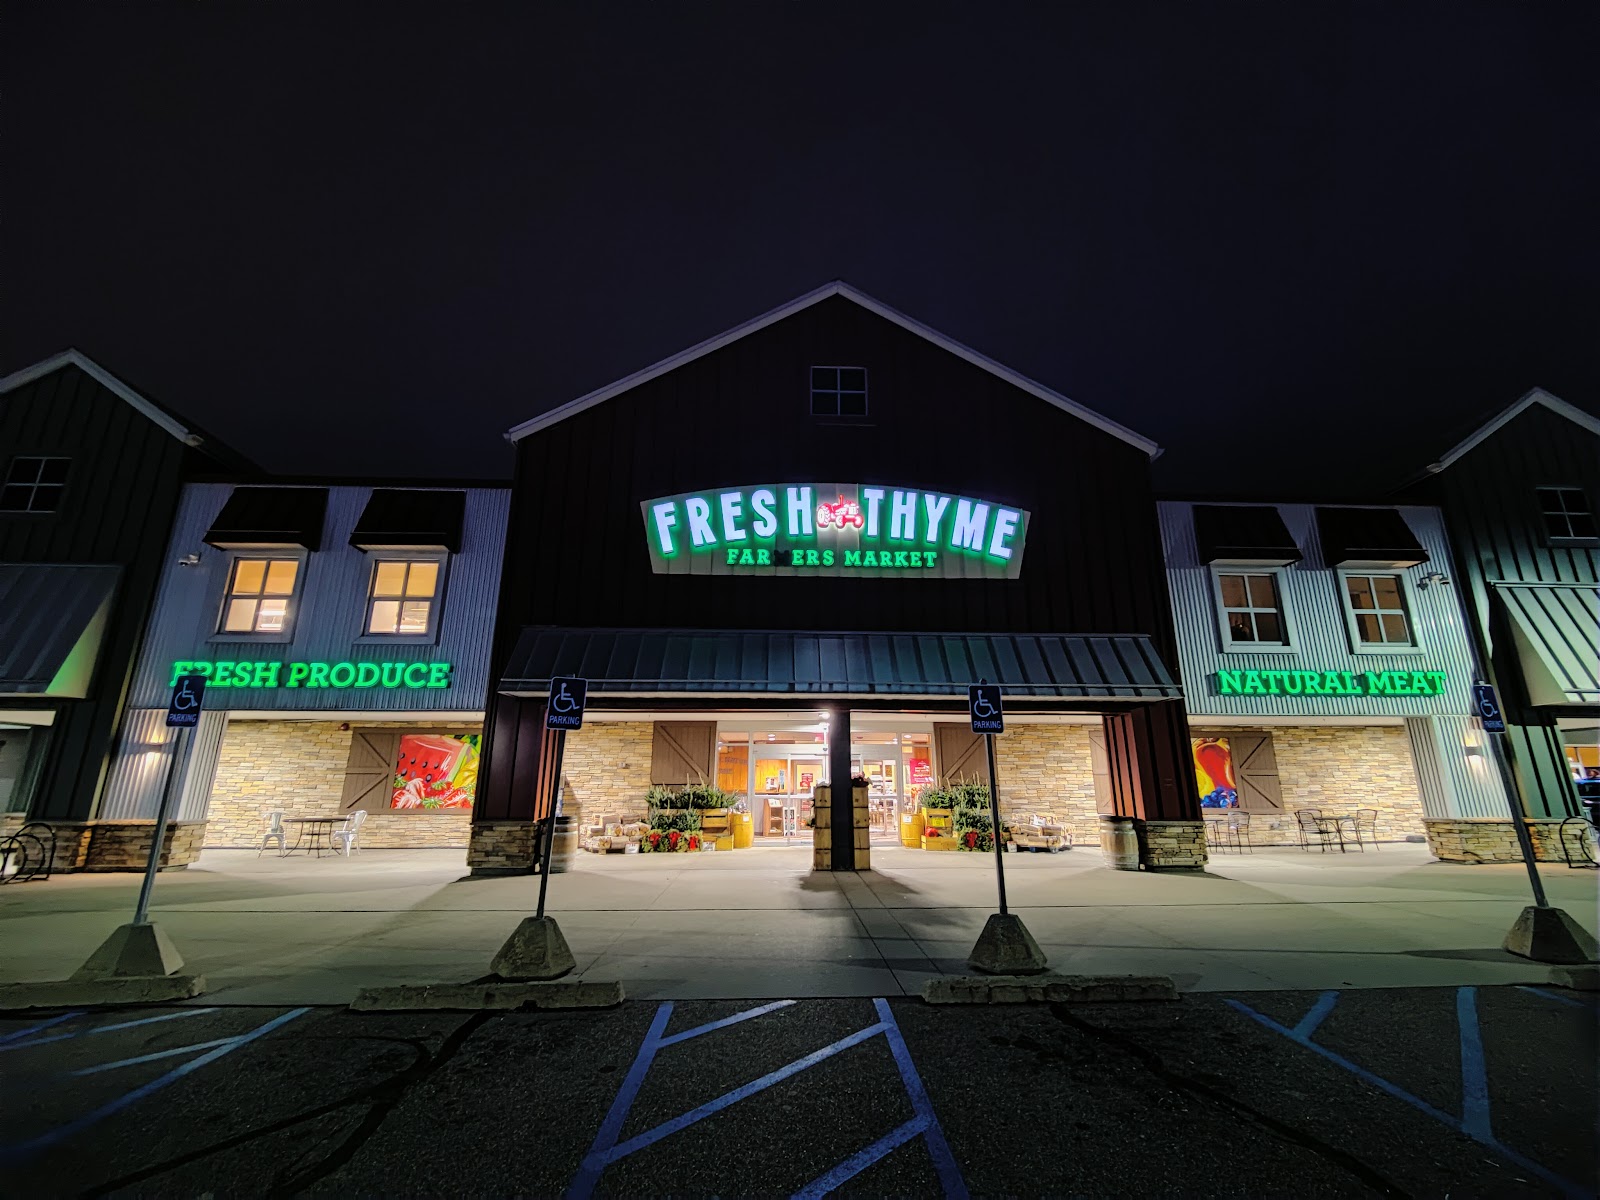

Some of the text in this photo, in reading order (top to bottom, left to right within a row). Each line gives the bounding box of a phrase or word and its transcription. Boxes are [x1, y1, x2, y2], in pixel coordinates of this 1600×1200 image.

[653, 486, 1020, 560] FRESH THYME
[844, 550, 938, 569] MARKET
[286, 662, 450, 689] PRODUCE
[1217, 670, 1447, 696] NATURAL MEAT
[168, 713, 197, 723] PARKING
[549, 715, 580, 725] PARKING
[973, 720, 1002, 729] PARKING
